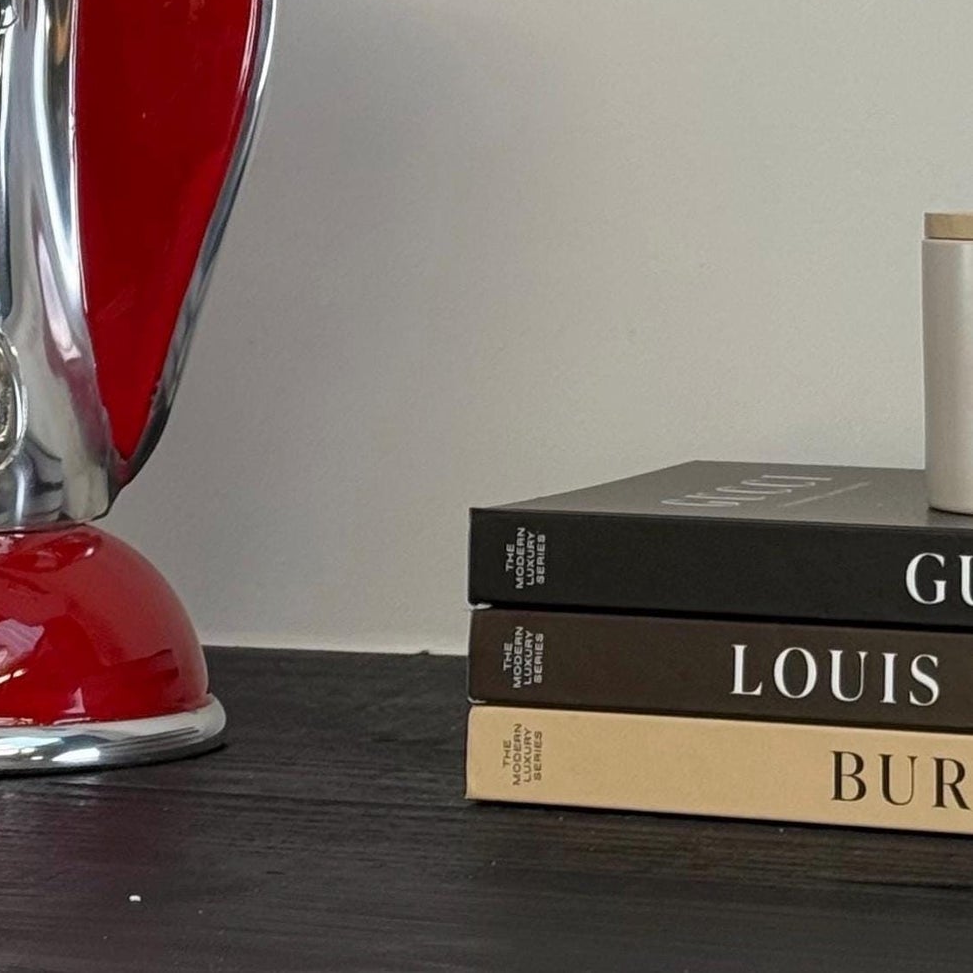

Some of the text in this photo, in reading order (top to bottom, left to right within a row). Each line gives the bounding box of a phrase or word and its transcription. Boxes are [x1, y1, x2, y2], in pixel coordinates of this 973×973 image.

[505, 543, 515, 572] THE
[515, 527, 526, 589] MODERN
[526, 531, 536, 586] LUXURY
[536, 534, 546, 585] SERIES
[503, 642, 513, 672] THE
[512, 626, 524, 689] MODERN
[523, 630, 534, 685] LUXURY
[533, 633, 544, 684] SERIES
[729, 644, 940, 707] LOUIS
[502, 739, 512, 768] THE
[512, 723, 522, 786] MODERN
[523, 727, 533, 783] LUXURY
[533, 730, 543, 781] SERIES
[830, 750, 972, 811] BUR
